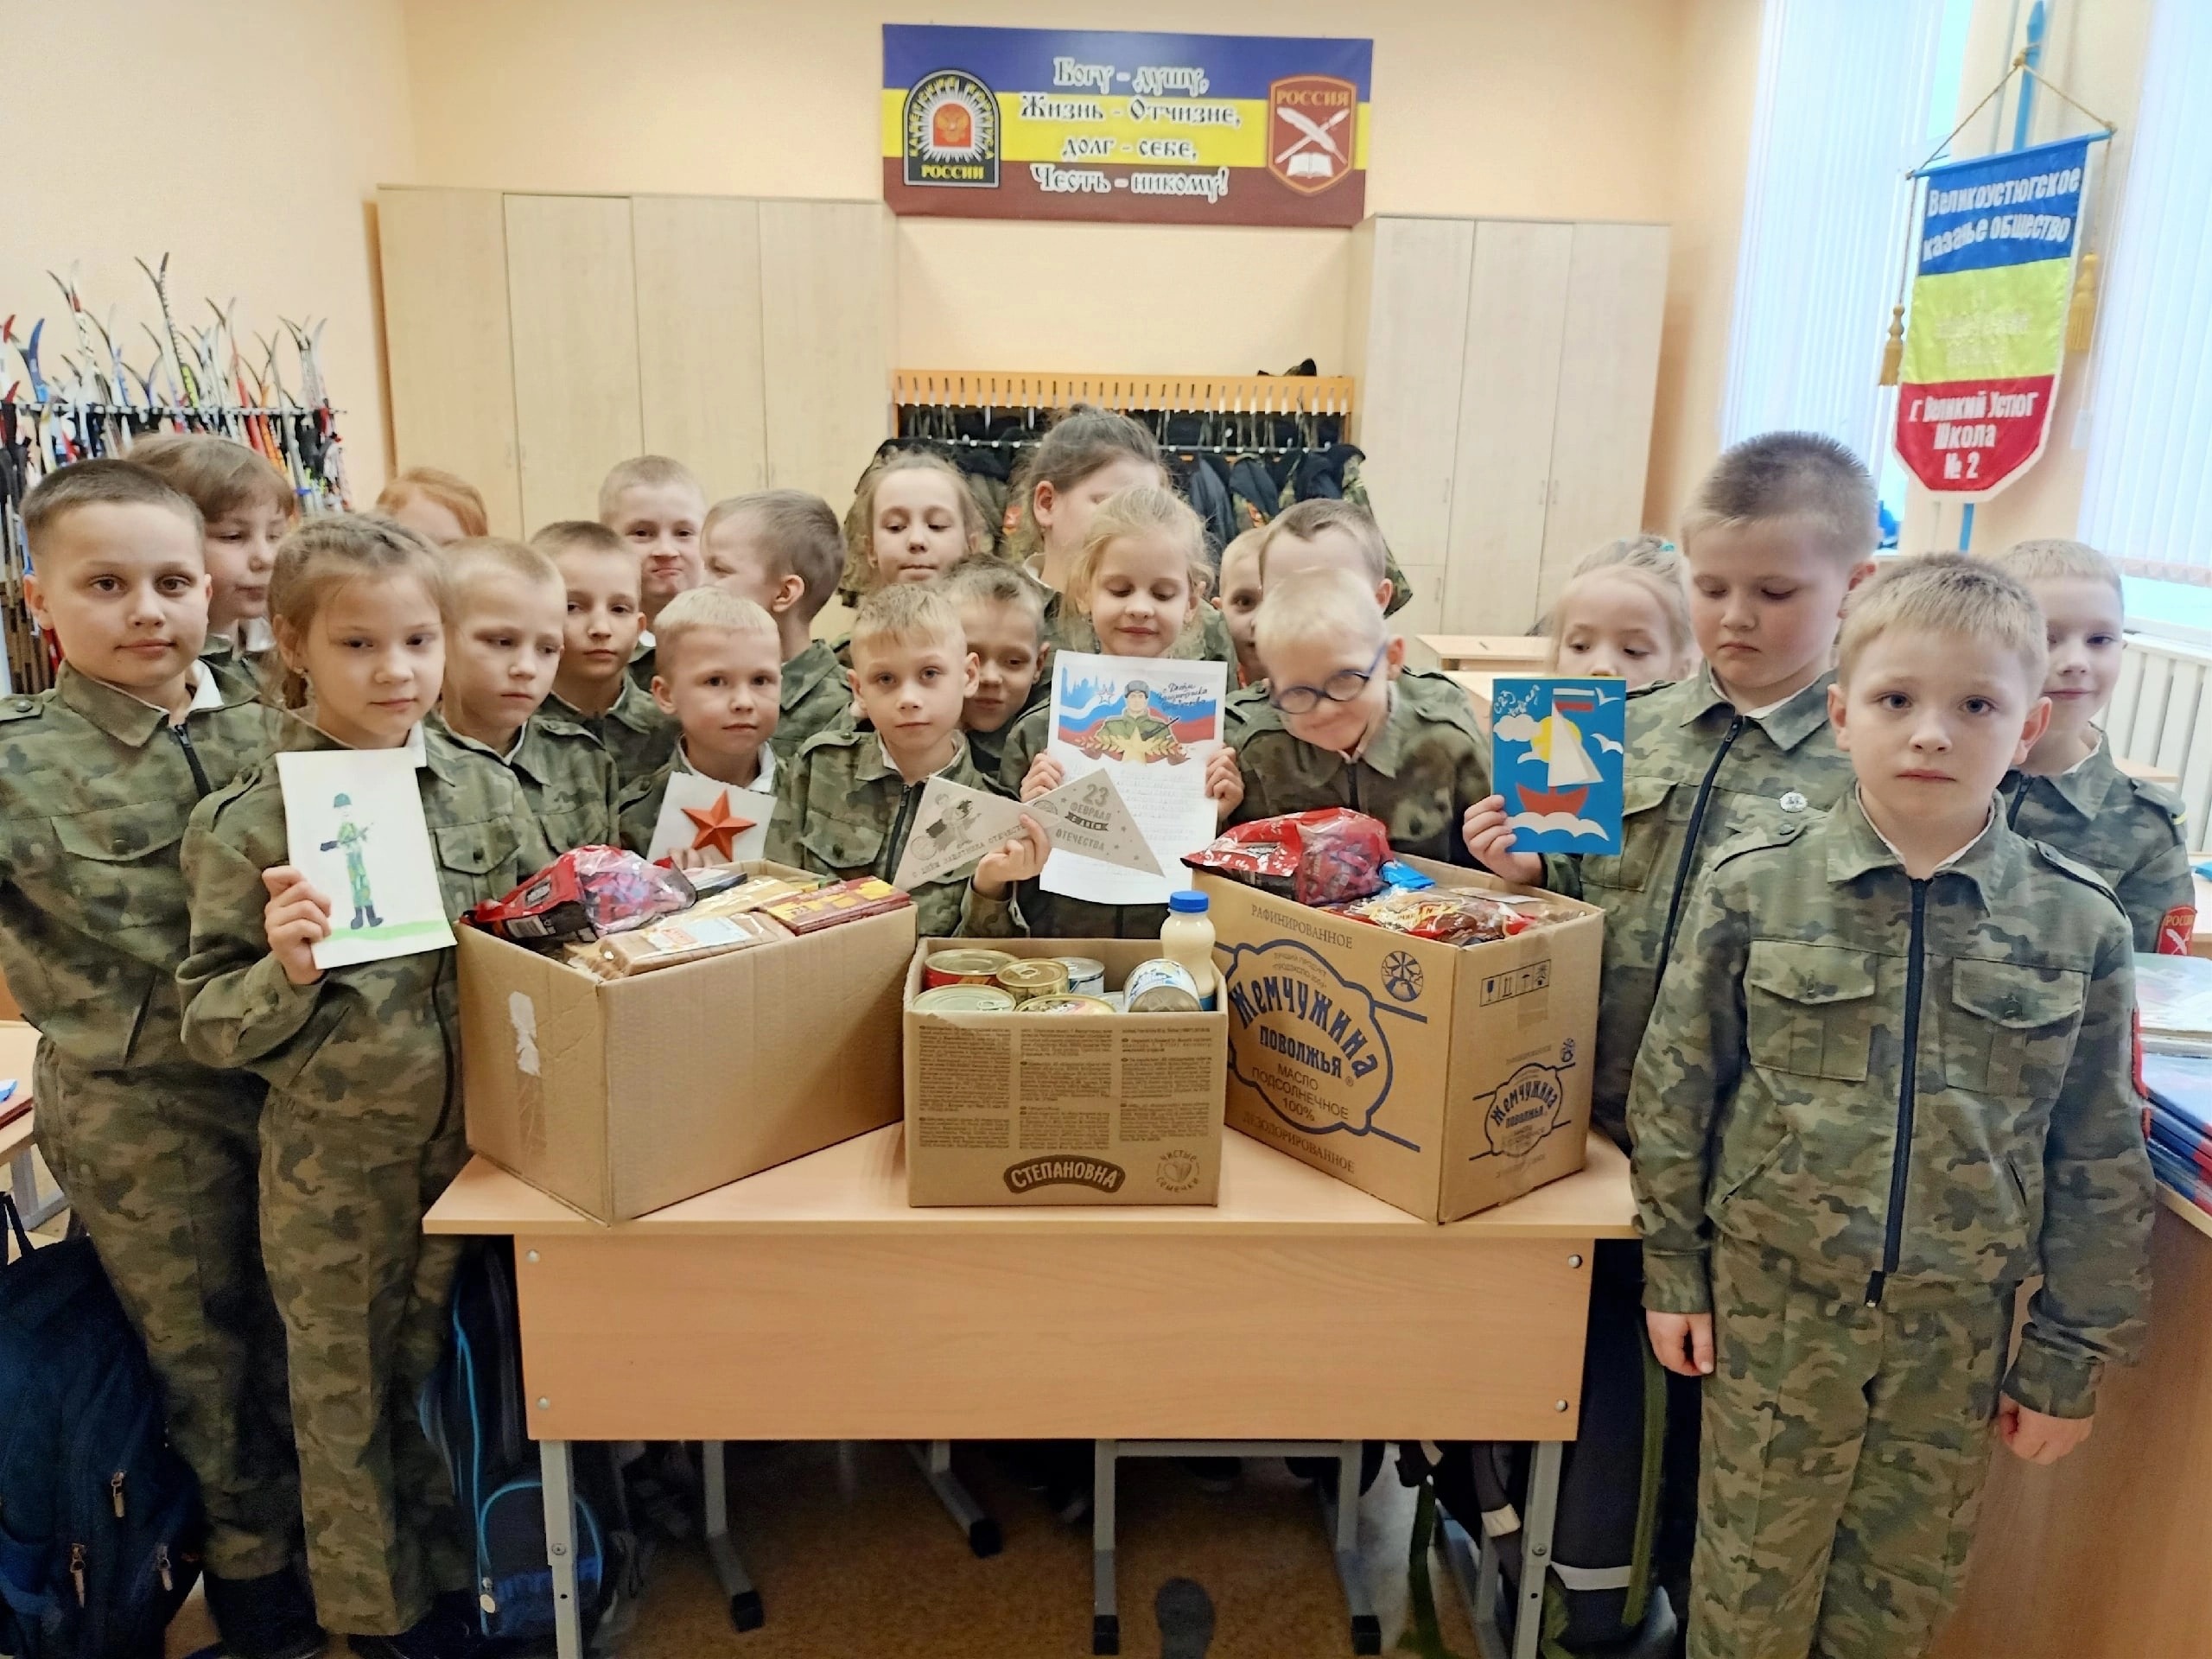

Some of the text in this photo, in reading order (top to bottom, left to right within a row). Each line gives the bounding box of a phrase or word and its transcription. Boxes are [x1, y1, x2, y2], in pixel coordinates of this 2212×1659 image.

[1021, 95, 1104, 119] Жизнь
[1129, 98, 1241, 127] Отчизне,
[1276, 90, 1350, 106] РОССИЯ
[1063, 138, 1115, 160] долг
[921, 164, 984, 180] РОССИИ
[1032, 165, 1111, 191] Честь
[1131, 167, 1230, 203] никому!
[1927, 168, 2082, 218] Великоустюгское
[1923, 391, 1986, 423] Великий
[1987, 391, 2040, 419] Устюг
[1934, 422, 1997, 450] Школа
[1943, 451, 1980, 480] № 2
[1083, 783, 1109, 807] 23
[1070, 802, 1112, 822] ФЕВРАЛЯ
[1056, 828, 1104, 851] ОТЕЧЕСТВА
[1251, 905, 1353, 950] РАФИНИРОВАННОЕ
[1278, 1063, 1319, 1090] МАСЛО
[1253, 1067, 1349, 1120] ПОДСОЛНЕЧНОЕ
[1283, 1097, 1315, 1122] 100%
[1243, 1115, 1355, 1174] ДЕЗОДОРИРОВАННОЕ
[1010, 1161, 1118, 1189] СТЕПАНОВНА
